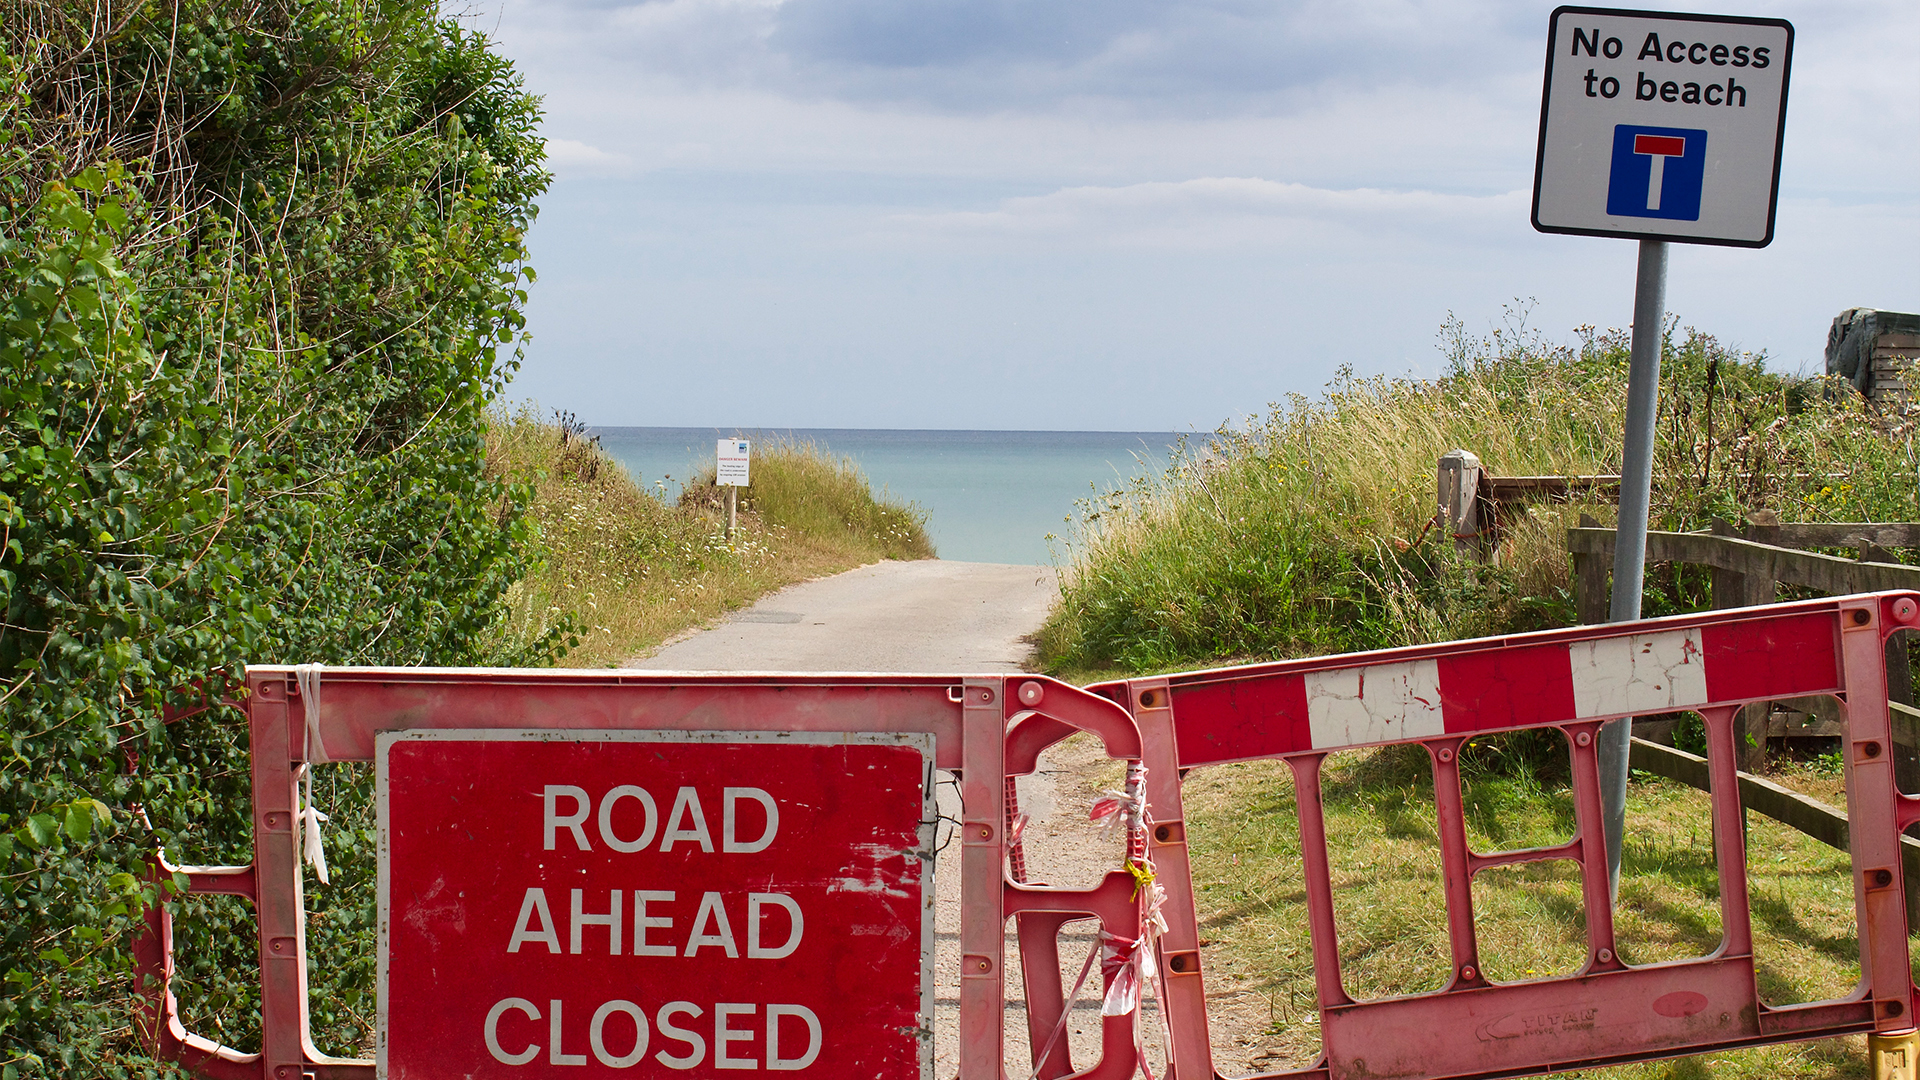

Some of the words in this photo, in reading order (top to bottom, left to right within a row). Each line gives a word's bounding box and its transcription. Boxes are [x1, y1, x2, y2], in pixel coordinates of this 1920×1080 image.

[1571, 27, 1623, 60] No
[1637, 32, 1771, 69] Access
[1583, 68, 1620, 99] to
[1635, 71, 1747, 108] beach
[542, 784, 780, 854] ROAD
[506, 887, 804, 960] AHEAD
[484, 997, 823, 1071] CLOSED
[1521, 1008, 1595, 1029] TITAN
